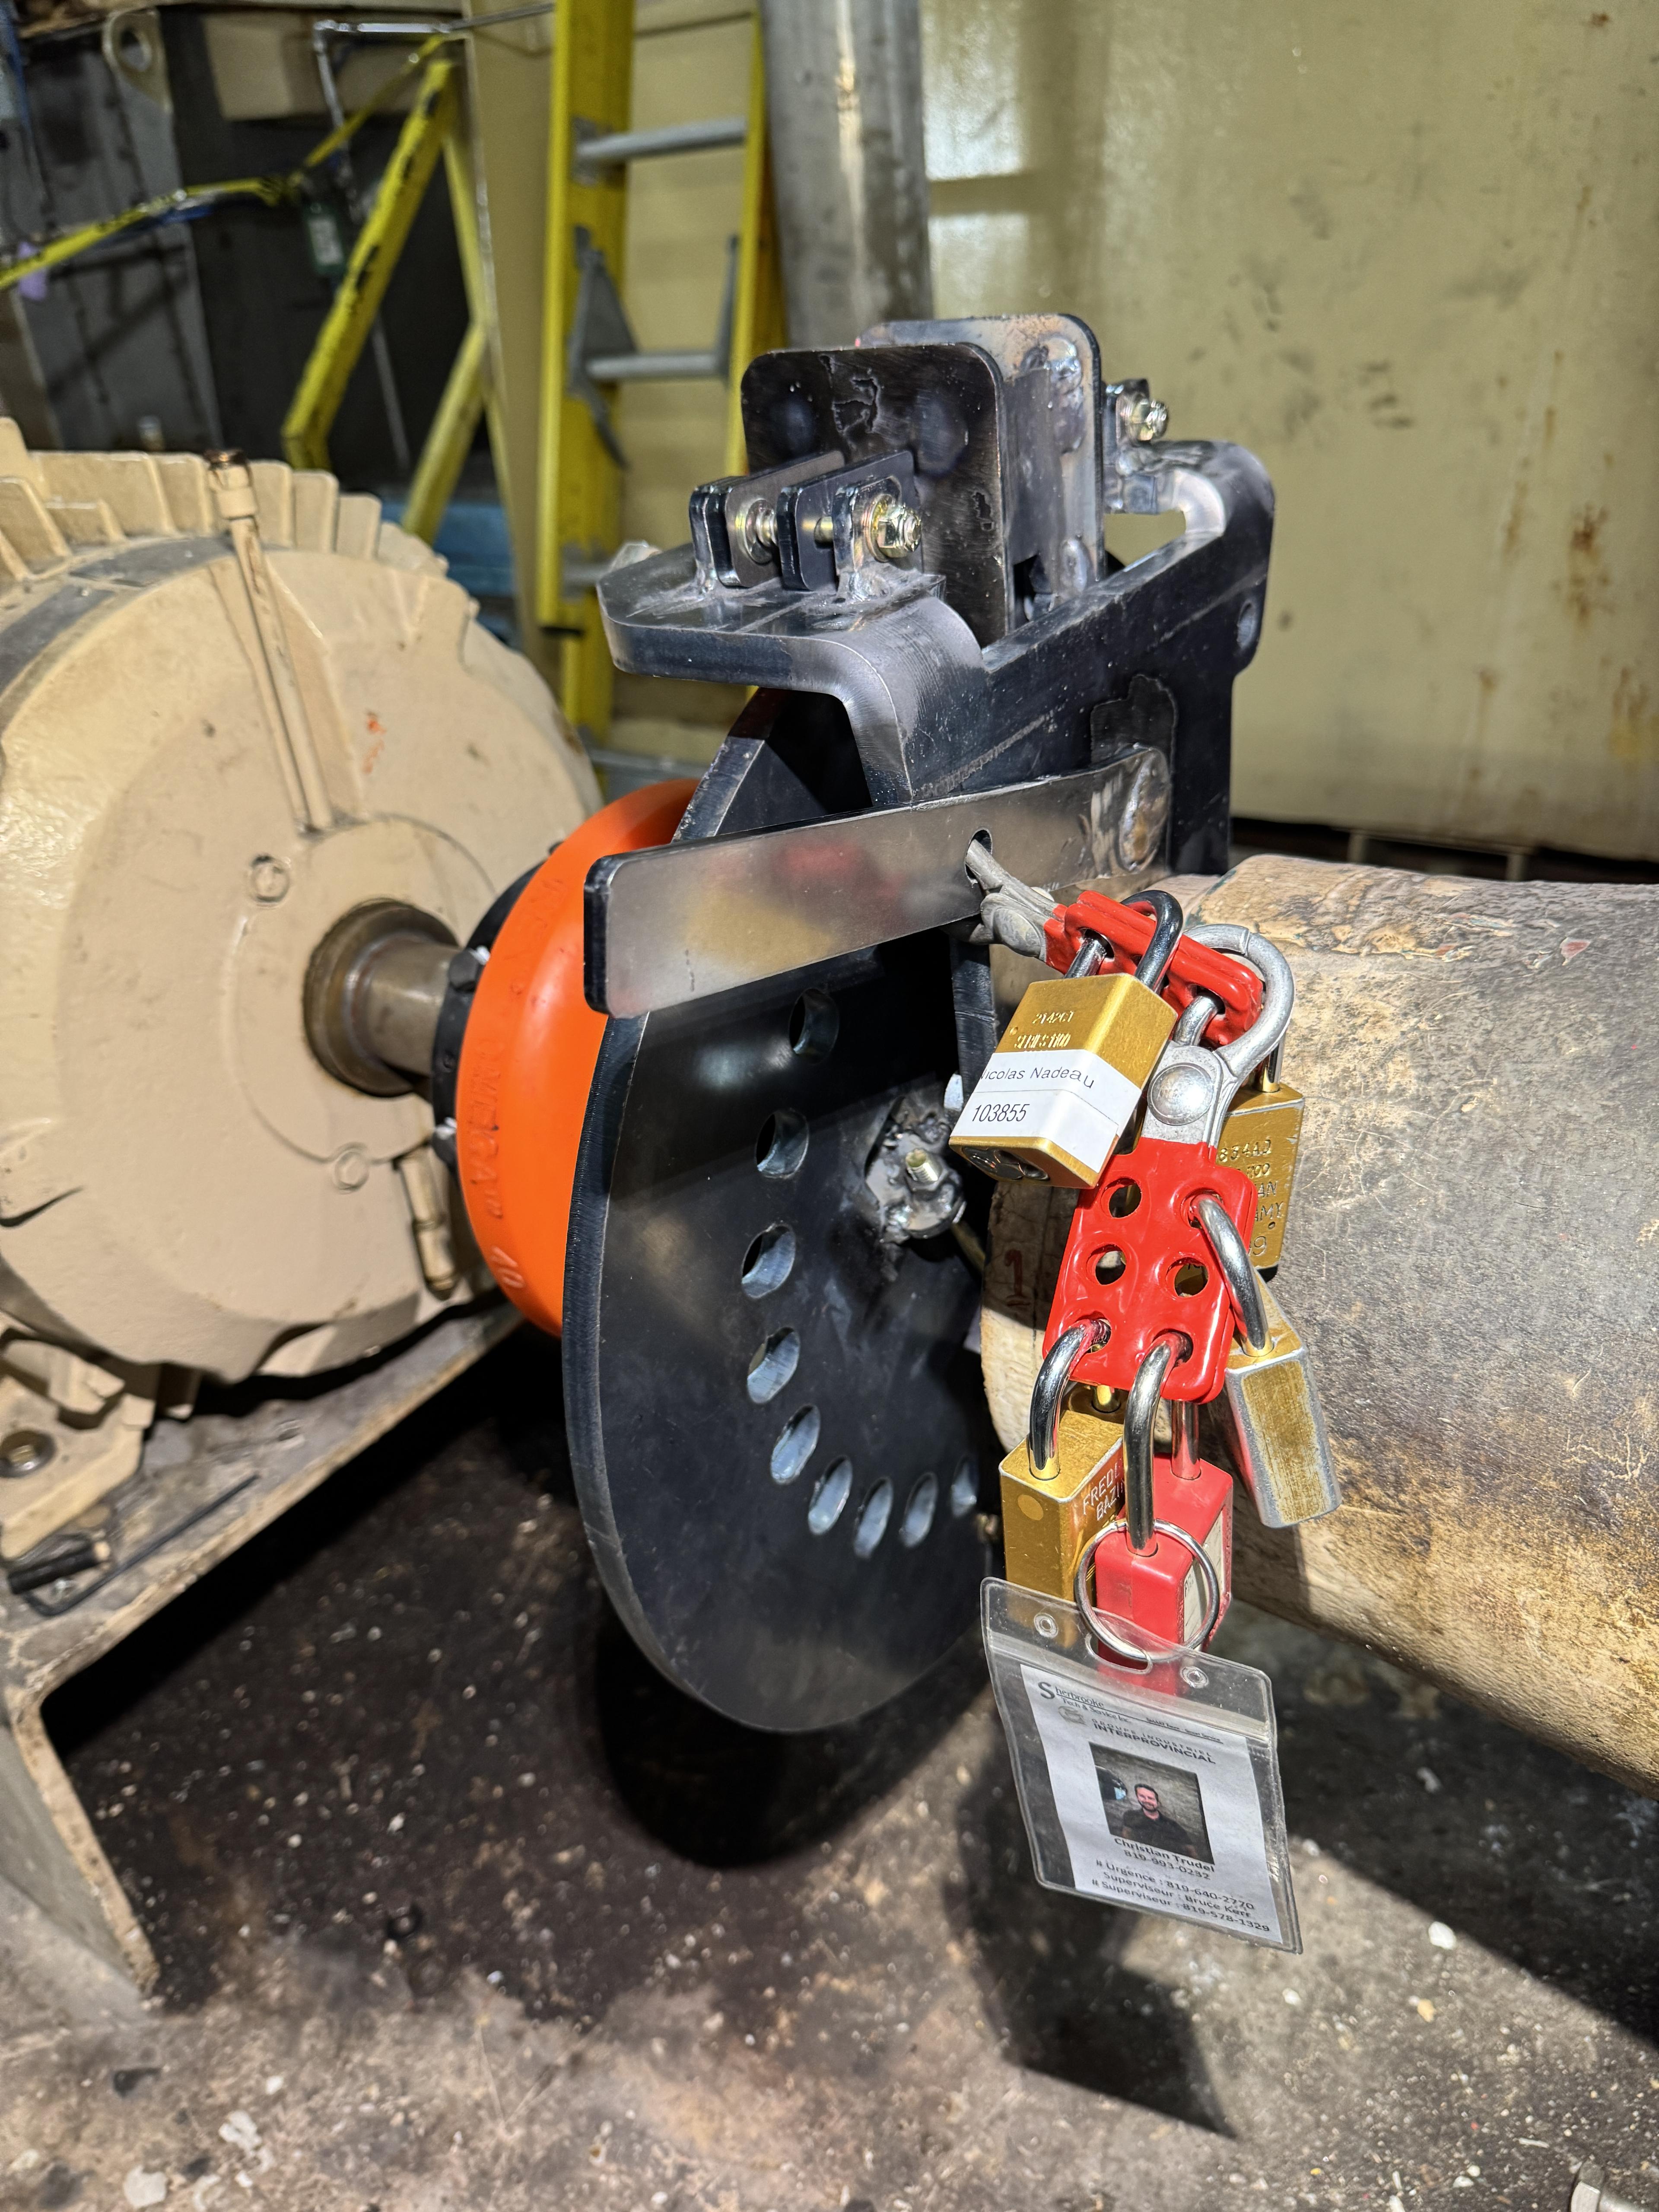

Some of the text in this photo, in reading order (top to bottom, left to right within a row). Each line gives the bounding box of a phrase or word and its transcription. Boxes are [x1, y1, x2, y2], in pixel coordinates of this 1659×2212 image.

[1030, 1067, 1094, 1088] Nadeau
[972, 1104, 1030, 1122] 103855
[1255, 1180, 1279, 1197] AN
[1038, 1682, 1104, 1708] Sherbrooke
[1094, 1723, 1216, 1764] INTERPROVINCIAL
[1114, 1838, 1215, 1872] Christian Trudel
[1106, 1862, 1155, 1882] Urgence
[1102, 1881, 1170, 1906] Superviseur
[1103, 1872, 1173, 1897] Superviseur
[1185, 1895, 1220, 1910] Bruce
